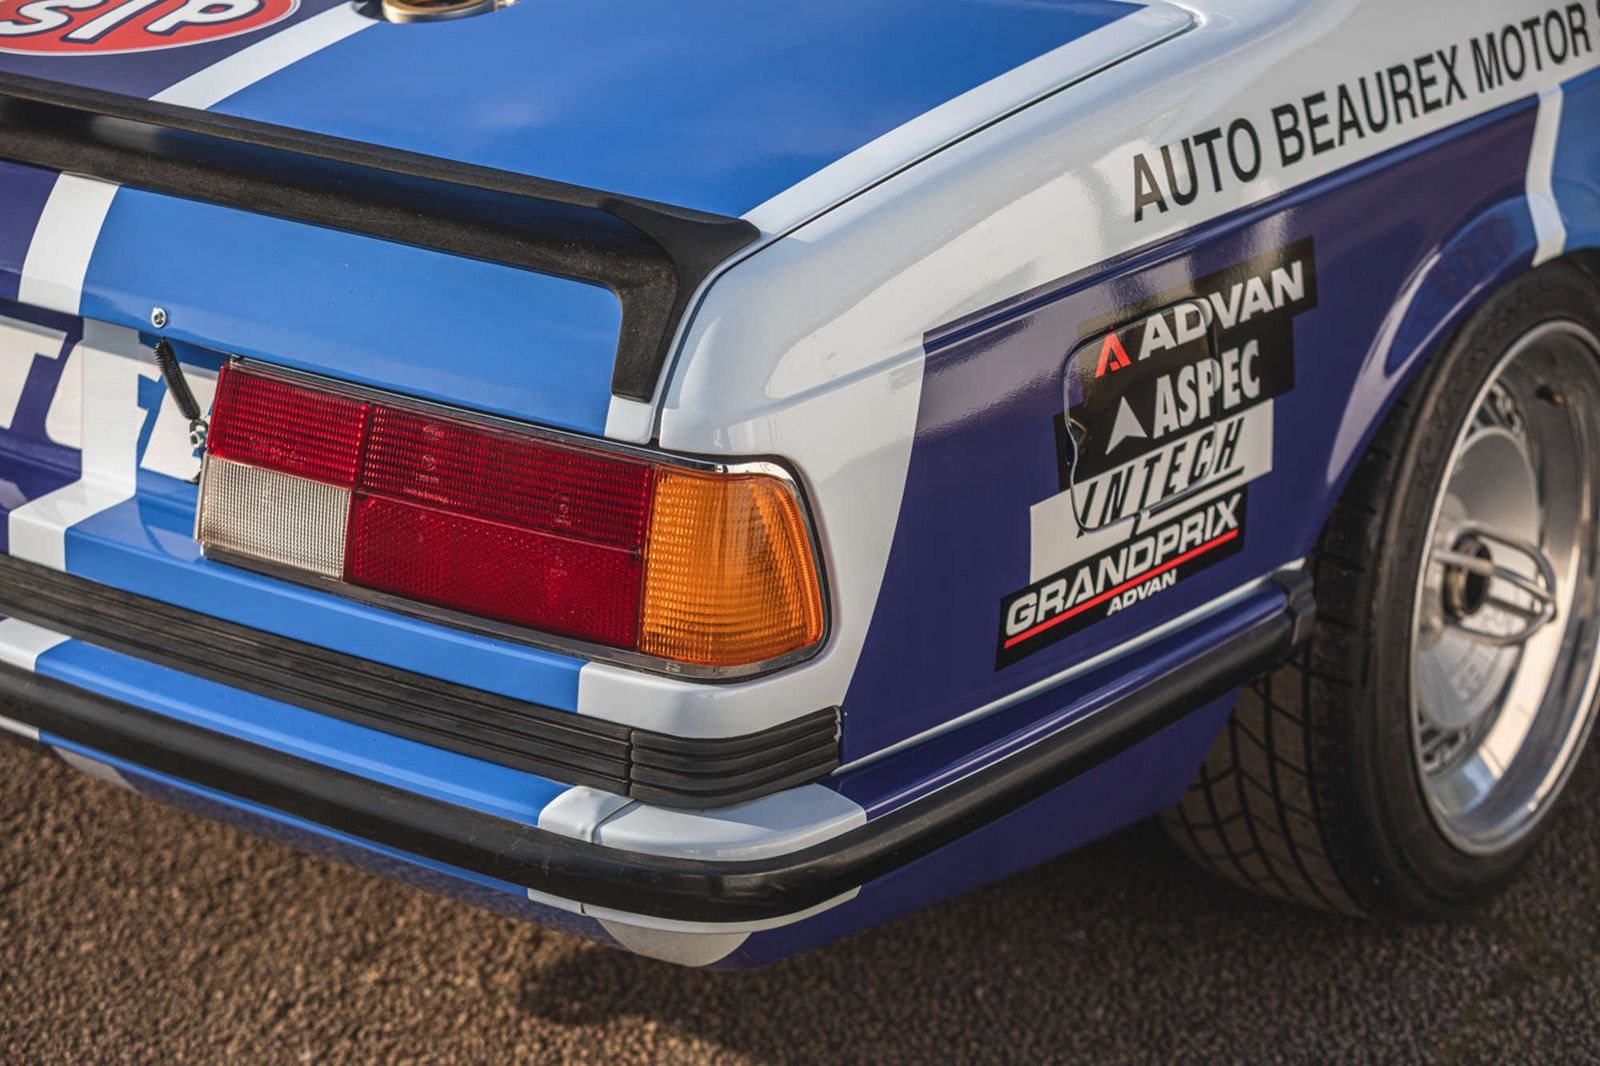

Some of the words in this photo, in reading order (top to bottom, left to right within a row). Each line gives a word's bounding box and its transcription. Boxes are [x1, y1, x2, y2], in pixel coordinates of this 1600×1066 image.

[1132, 117, 1262, 223] AUTO
[1270, 44, 1468, 168] BEAUREX
[1468, 2, 1593, 94] MOTOR
[1138, 260, 1305, 361] ADVAN
[1152, 338, 1262, 440] ASPEC
[1075, 415, 1246, 539] INTECH
[1005, 492, 1243, 637] GRANDPRIX
[1106, 568, 1178, 617] ADVAN
